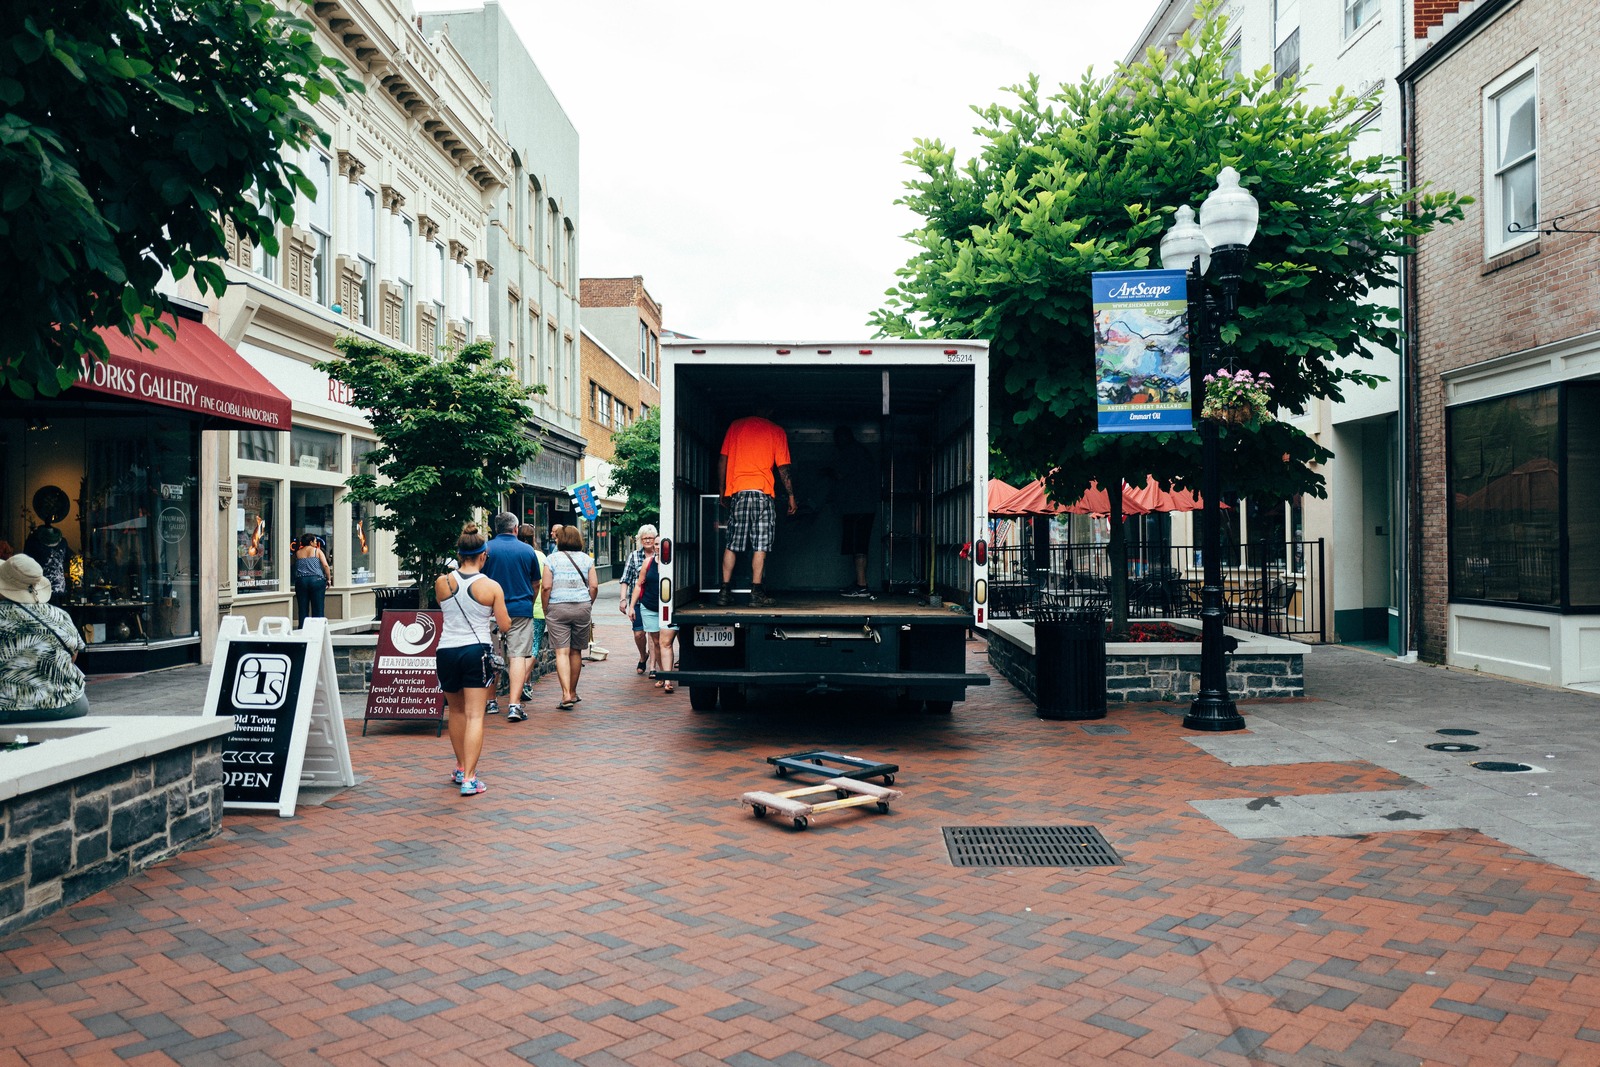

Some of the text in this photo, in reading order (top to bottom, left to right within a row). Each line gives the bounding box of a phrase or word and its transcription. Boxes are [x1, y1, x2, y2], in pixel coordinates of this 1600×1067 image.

[1108, 282, 1171, 298] ArtScape
[947, 354, 973, 362] 525214
[139, 372, 199, 406] GALLERY
[200, 395, 215, 410] FINE
[215, 397, 241, 417] GLOBAL
[241, 407, 279, 425] HANDCRAFTS
[578, 488, 595, 516] OPEN
[695, 631, 733, 642] XAJ-1090
[382, 658, 436, 667] HANDWORKS
[392, 677, 425, 685] American
[371, 686, 397, 696] Jewelry
[406, 686, 444, 694] Handcrafts
[375, 696, 399, 704] Global
[400, 696, 423, 704] Ethnic
[369, 706, 383, 714] 150
[384, 706, 394, 714] N.
[428, 707, 439, 715] St.
[250, 715, 277, 725] Town
[233, 724, 275, 733] ilversmiths
